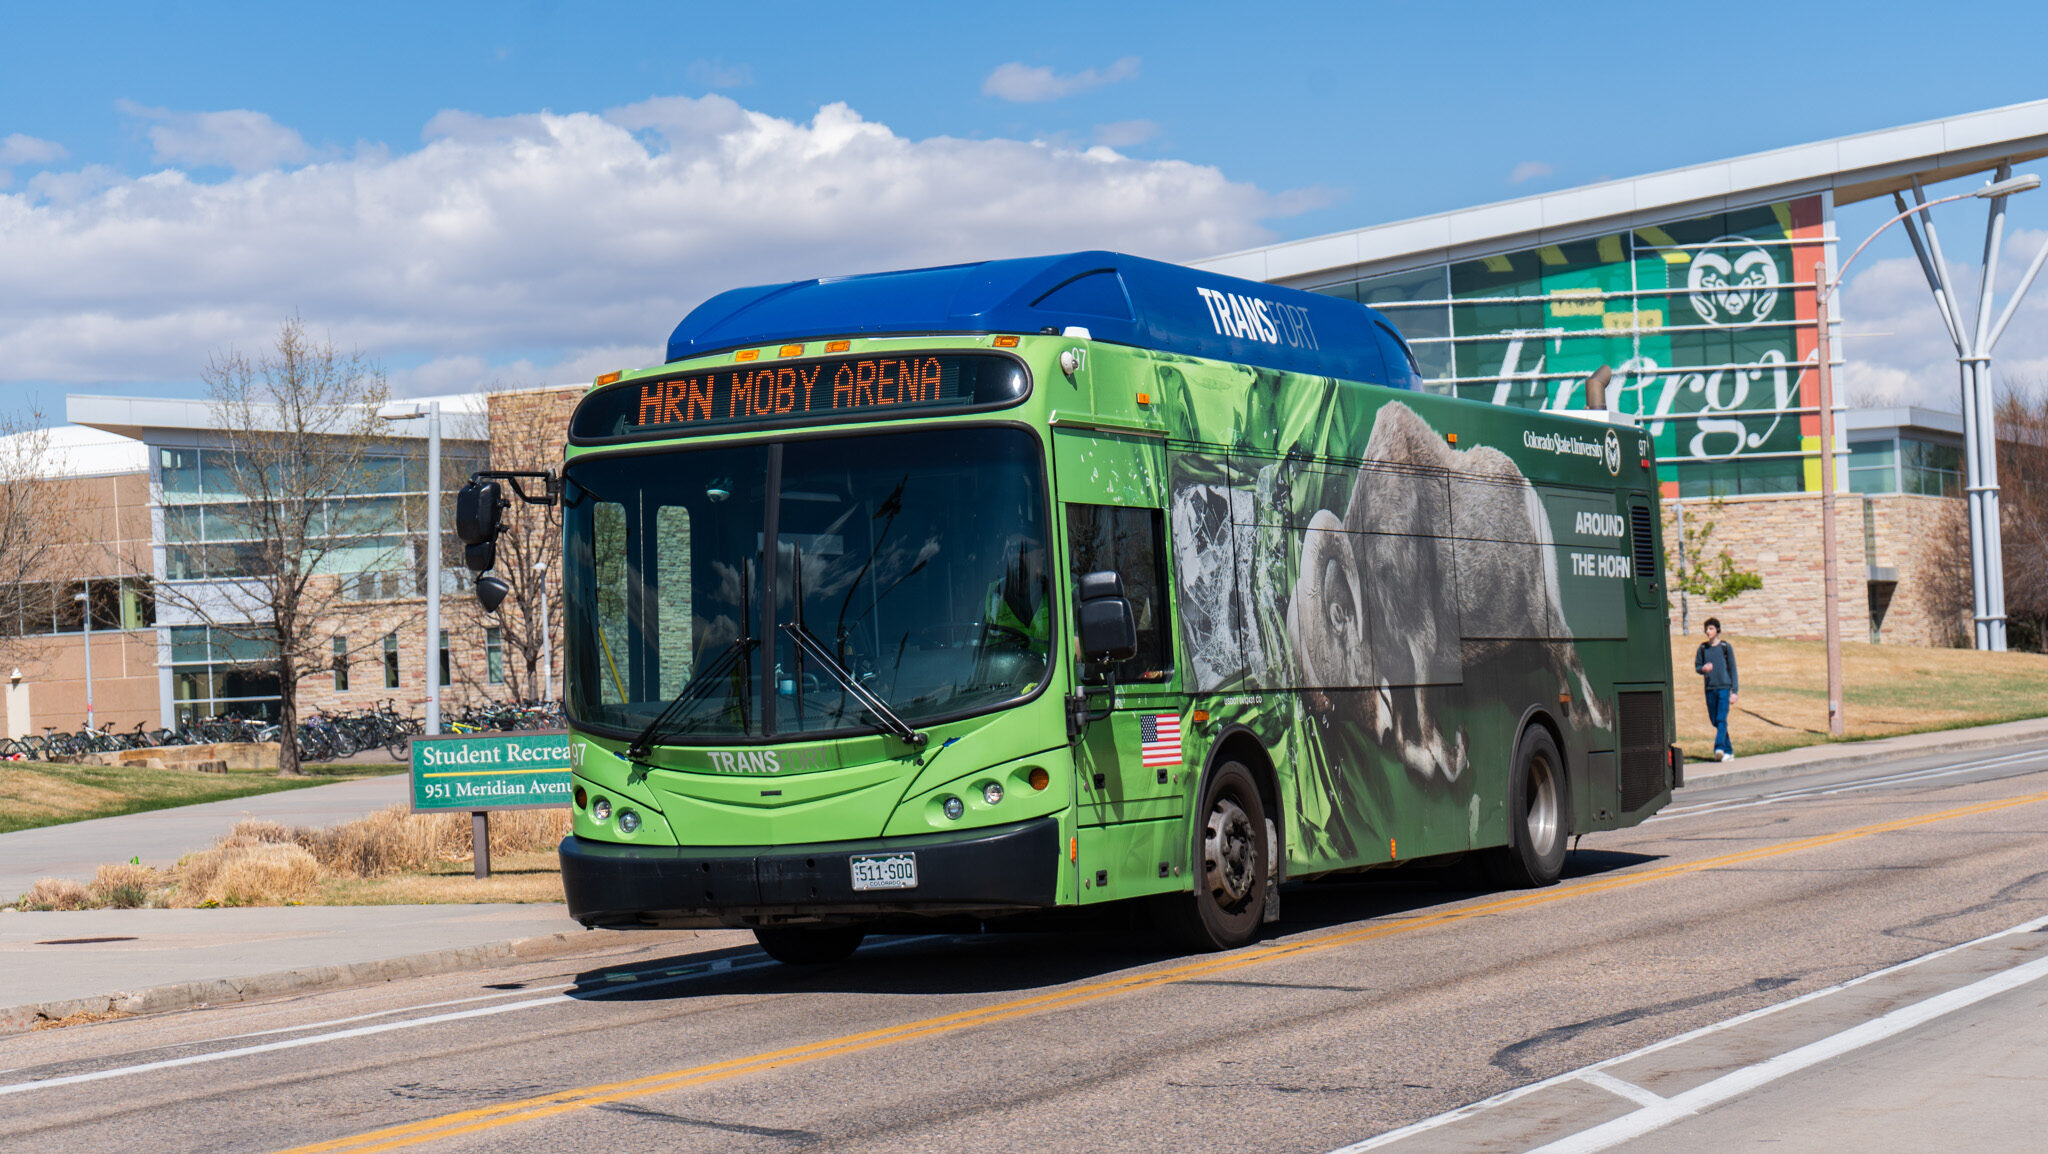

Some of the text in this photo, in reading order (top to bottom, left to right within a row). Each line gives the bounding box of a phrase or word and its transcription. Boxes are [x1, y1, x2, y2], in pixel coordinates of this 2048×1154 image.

[1196, 286, 1319, 351] TRANSFORT
[638, 357, 941, 425] HRN MOBY ARENA
[1523, 430, 1604, 465] Colorado State University
[1638, 439, 1647, 456] 97
[1575, 511, 1624, 537] AROUND
[1570, 552, 1631, 578] THE HORN
[423, 745, 501, 766] Student
[571, 742, 587, 766] 97
[425, 783, 450, 799] 951
[455, 780, 526, 797] Meridian
